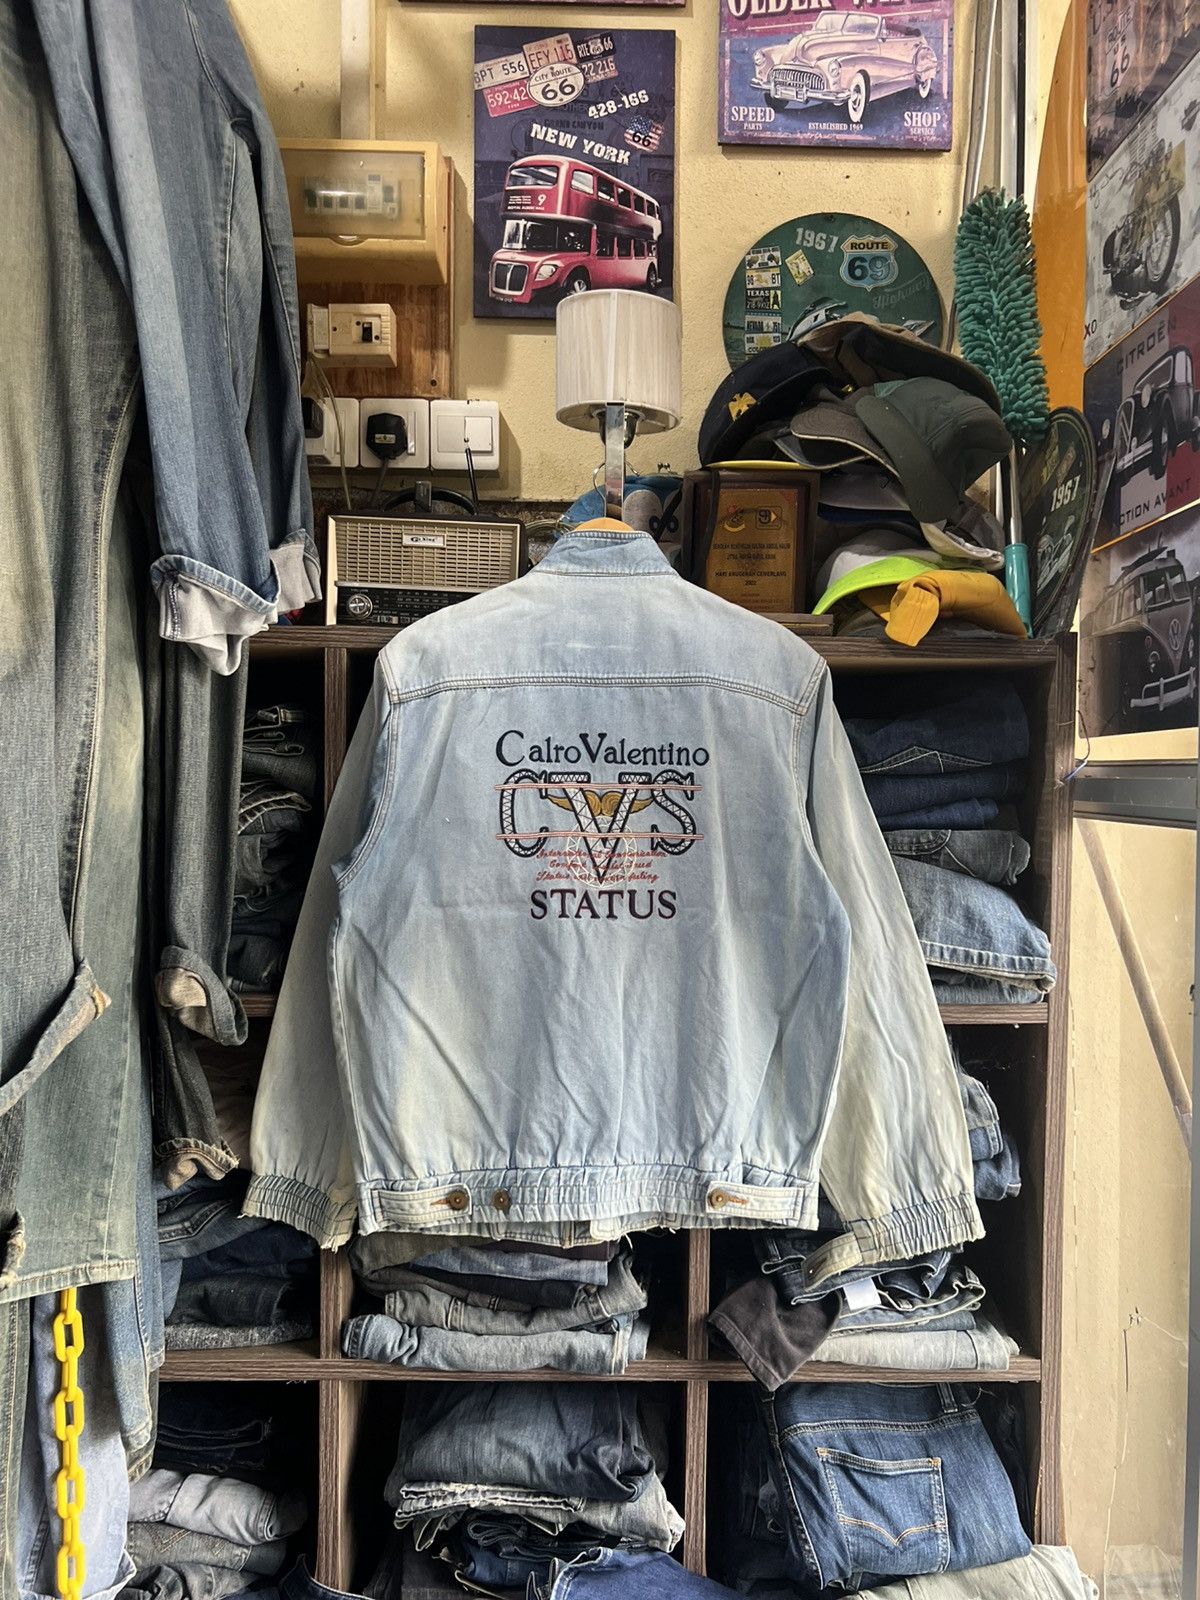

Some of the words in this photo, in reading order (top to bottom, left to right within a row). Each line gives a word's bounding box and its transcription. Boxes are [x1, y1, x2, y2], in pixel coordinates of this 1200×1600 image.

[502, 60, 525, 76] 556
[535, 72, 549, 83] CITY
[551, 66, 572, 78] ROUTE
[1110, 46, 1131, 88] 66
[541, 78, 576, 101] 66
[588, 89, 650, 119] 428-166
[731, 105, 775, 122] SPEED
[903, 111, 942, 127] SHOP
[530, 123, 578, 149] NEW
[583, 138, 631, 166] YORK
[632, 131, 653, 147] 66
[537, 193, 547, 206] 9
[795, 227, 839, 253] 1967
[850, 241, 889, 251] ROUTE
[847, 255, 891, 281] 69
[747, 290, 770, 298] TEXAS
[1051, 474, 1081, 512] 1967
[530, 888, 677, 920] STATUS
